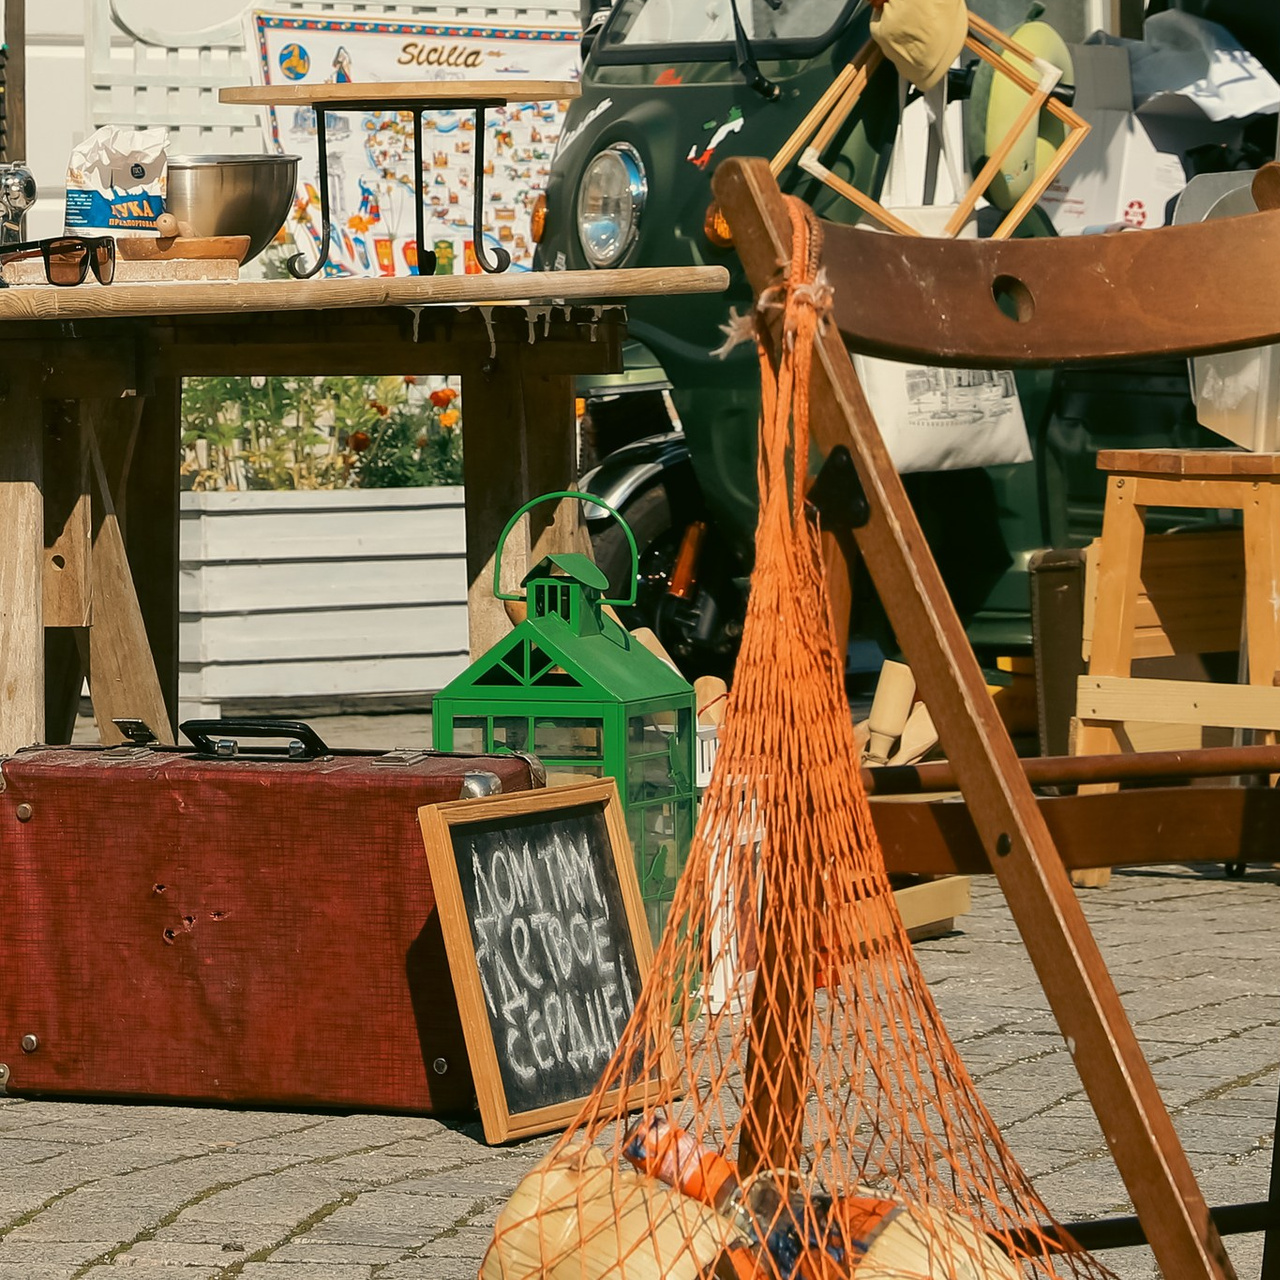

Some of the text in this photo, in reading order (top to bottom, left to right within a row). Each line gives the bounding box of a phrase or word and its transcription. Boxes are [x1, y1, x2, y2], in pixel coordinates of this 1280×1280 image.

[397, 42, 483, 68] Sicilia
[470, 841, 544, 937] ДОМ
[530, 911, 616, 986] ТВОЕ
